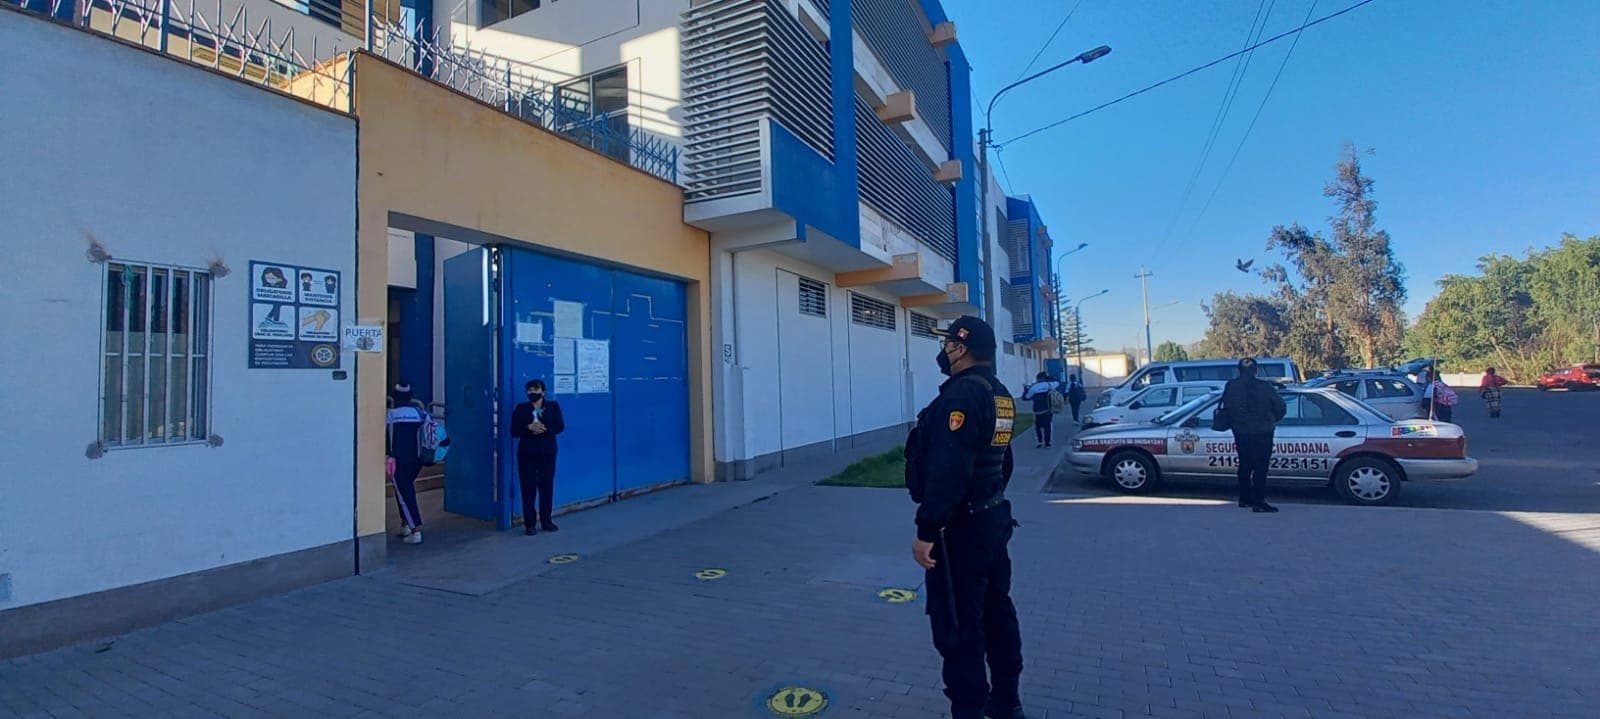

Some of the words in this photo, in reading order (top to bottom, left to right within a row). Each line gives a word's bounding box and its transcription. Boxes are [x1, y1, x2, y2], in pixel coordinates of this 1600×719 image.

[345, 327, 382, 338] PUERTA
[1205, 442, 1239, 454] SEGUR
[1270, 457, 1329, 470] 225151
